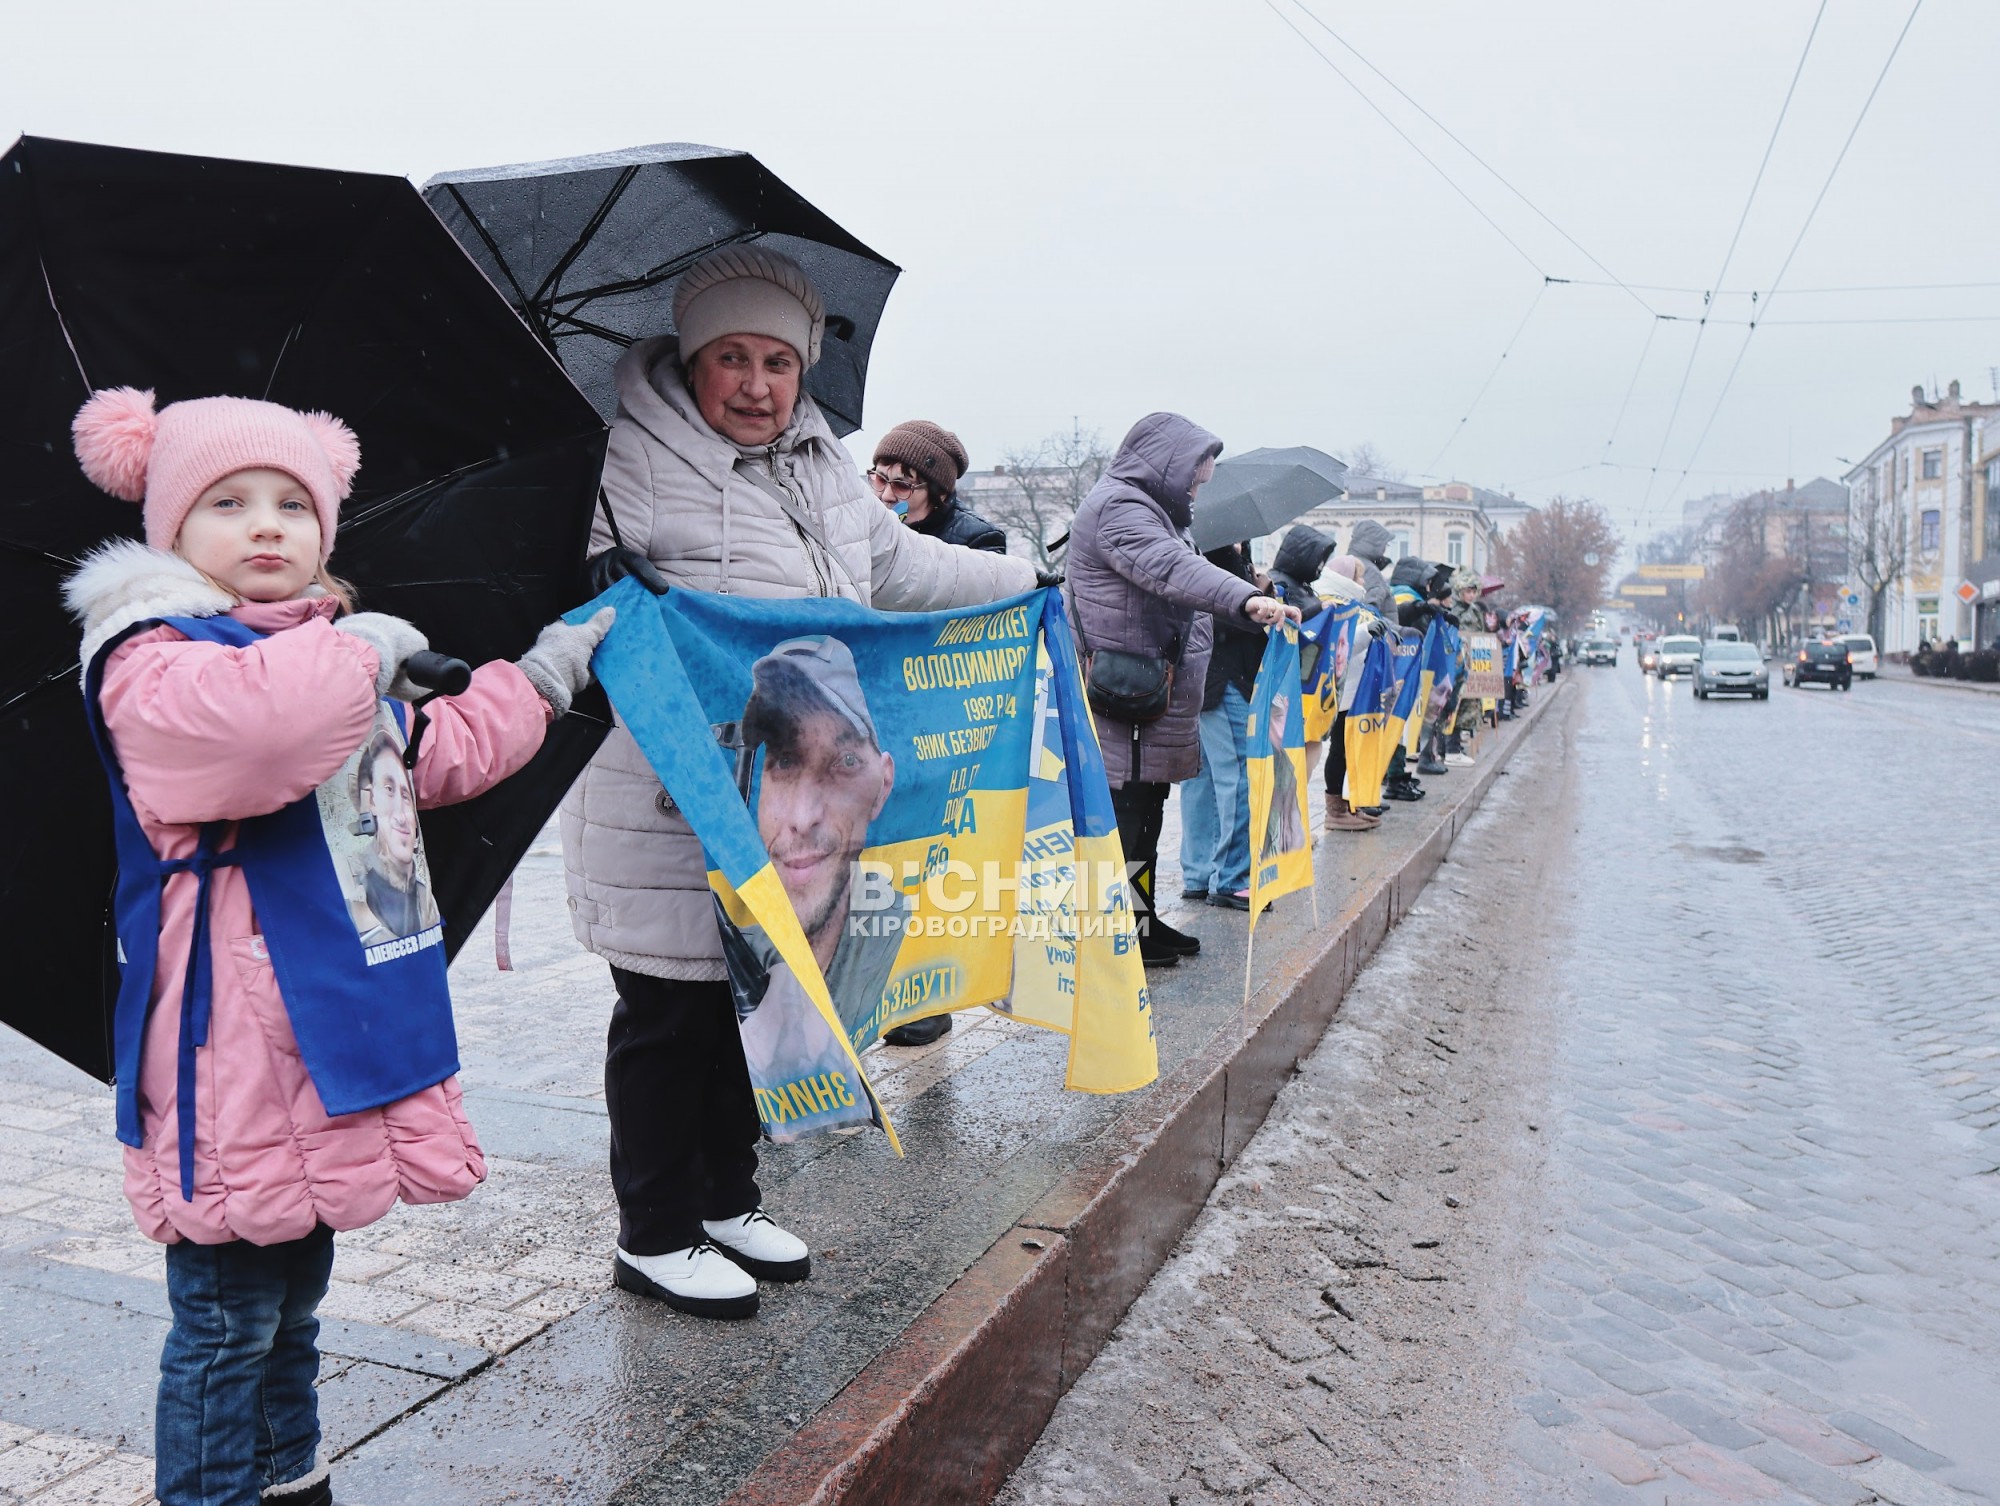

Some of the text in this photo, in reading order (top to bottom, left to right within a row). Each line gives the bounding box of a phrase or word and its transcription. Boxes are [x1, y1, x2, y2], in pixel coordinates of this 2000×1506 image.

[933, 614, 992, 647] ПАНОВ
[963, 695, 995, 722] 1982
[913, 732, 950, 761] ЗНИК
[891, 966, 956, 1013] ЗАБУТІ
